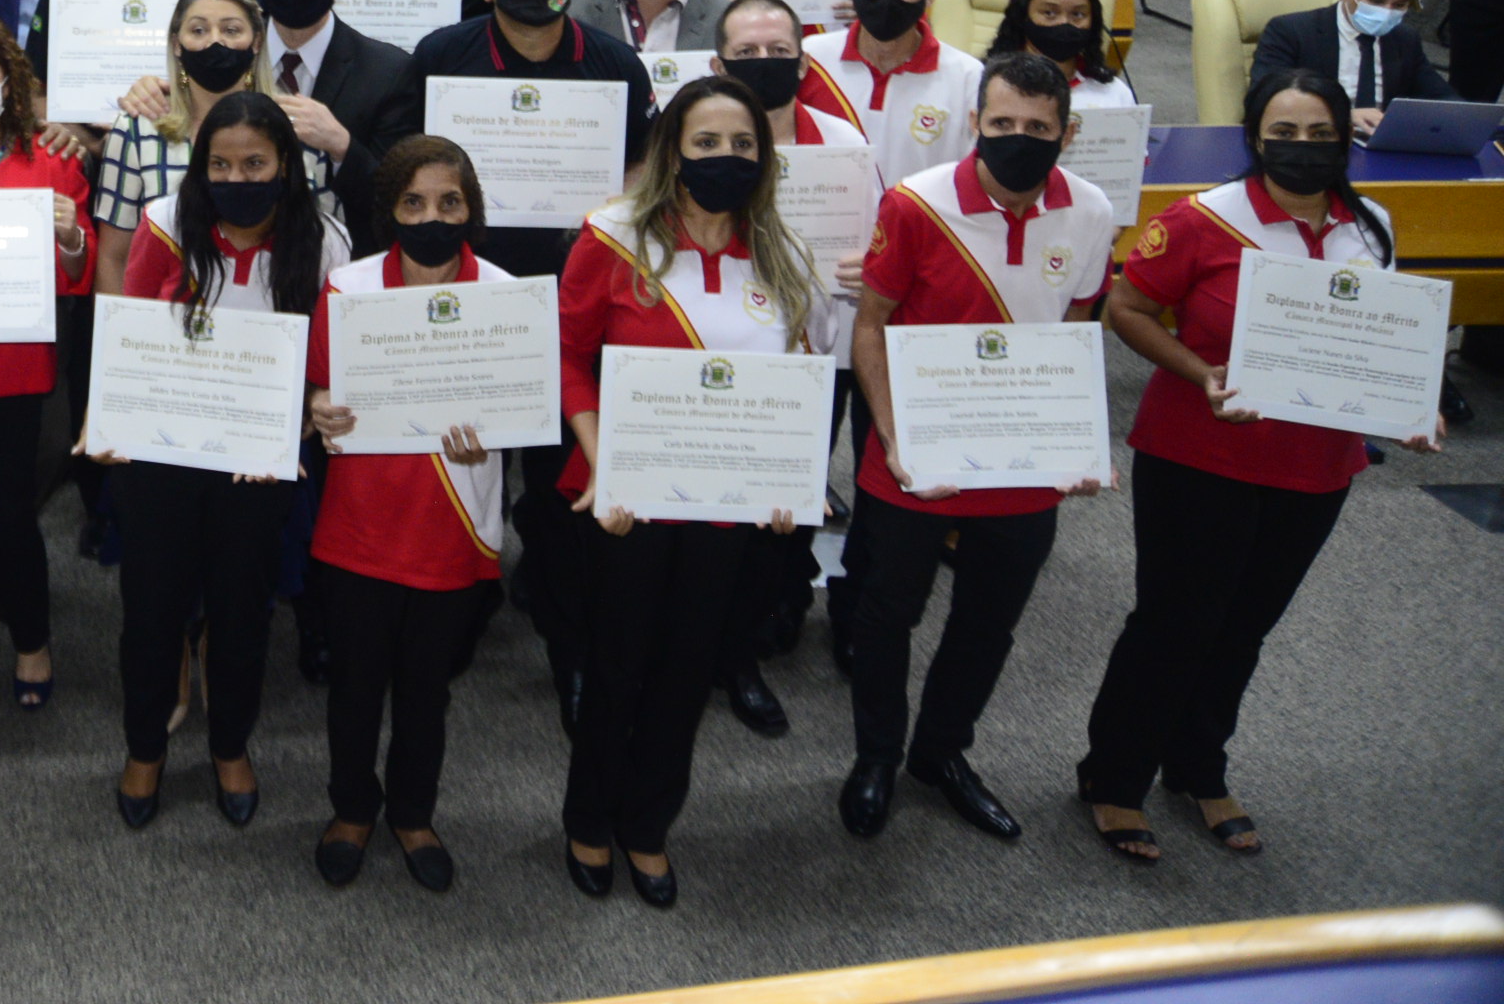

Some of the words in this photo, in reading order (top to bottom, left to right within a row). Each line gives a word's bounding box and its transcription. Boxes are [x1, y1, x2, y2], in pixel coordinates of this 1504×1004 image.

[451, 114, 494, 125] Diploma
[498, 115, 508, 126] de
[512, 115, 545, 127] Honra
[548, 117, 560, 127] ao
[1264, 292, 1309, 311] Diploma
[1312, 299, 1325, 313] de
[1328, 302, 1363, 320] Honra
[1365, 308, 1378, 322] ao
[360, 330, 407, 346] Diploma
[411, 329, 423, 342] de
[428, 326, 466, 341] Honra
[469, 325, 483, 338] ao
[120, 337, 164, 353] Diploma
[168, 342, 180, 355] de
[221, 347, 234, 361] ao
[915, 365, 961, 378] Diploma
[965, 364, 977, 377] de
[981, 363, 1017, 377] Honra
[1020, 363, 1033, 376] ao
[631, 390, 680, 405] Diploma
[684, 393, 697, 405] de
[702, 393, 740, 407] Honra
[743, 395, 757, 408] ao
